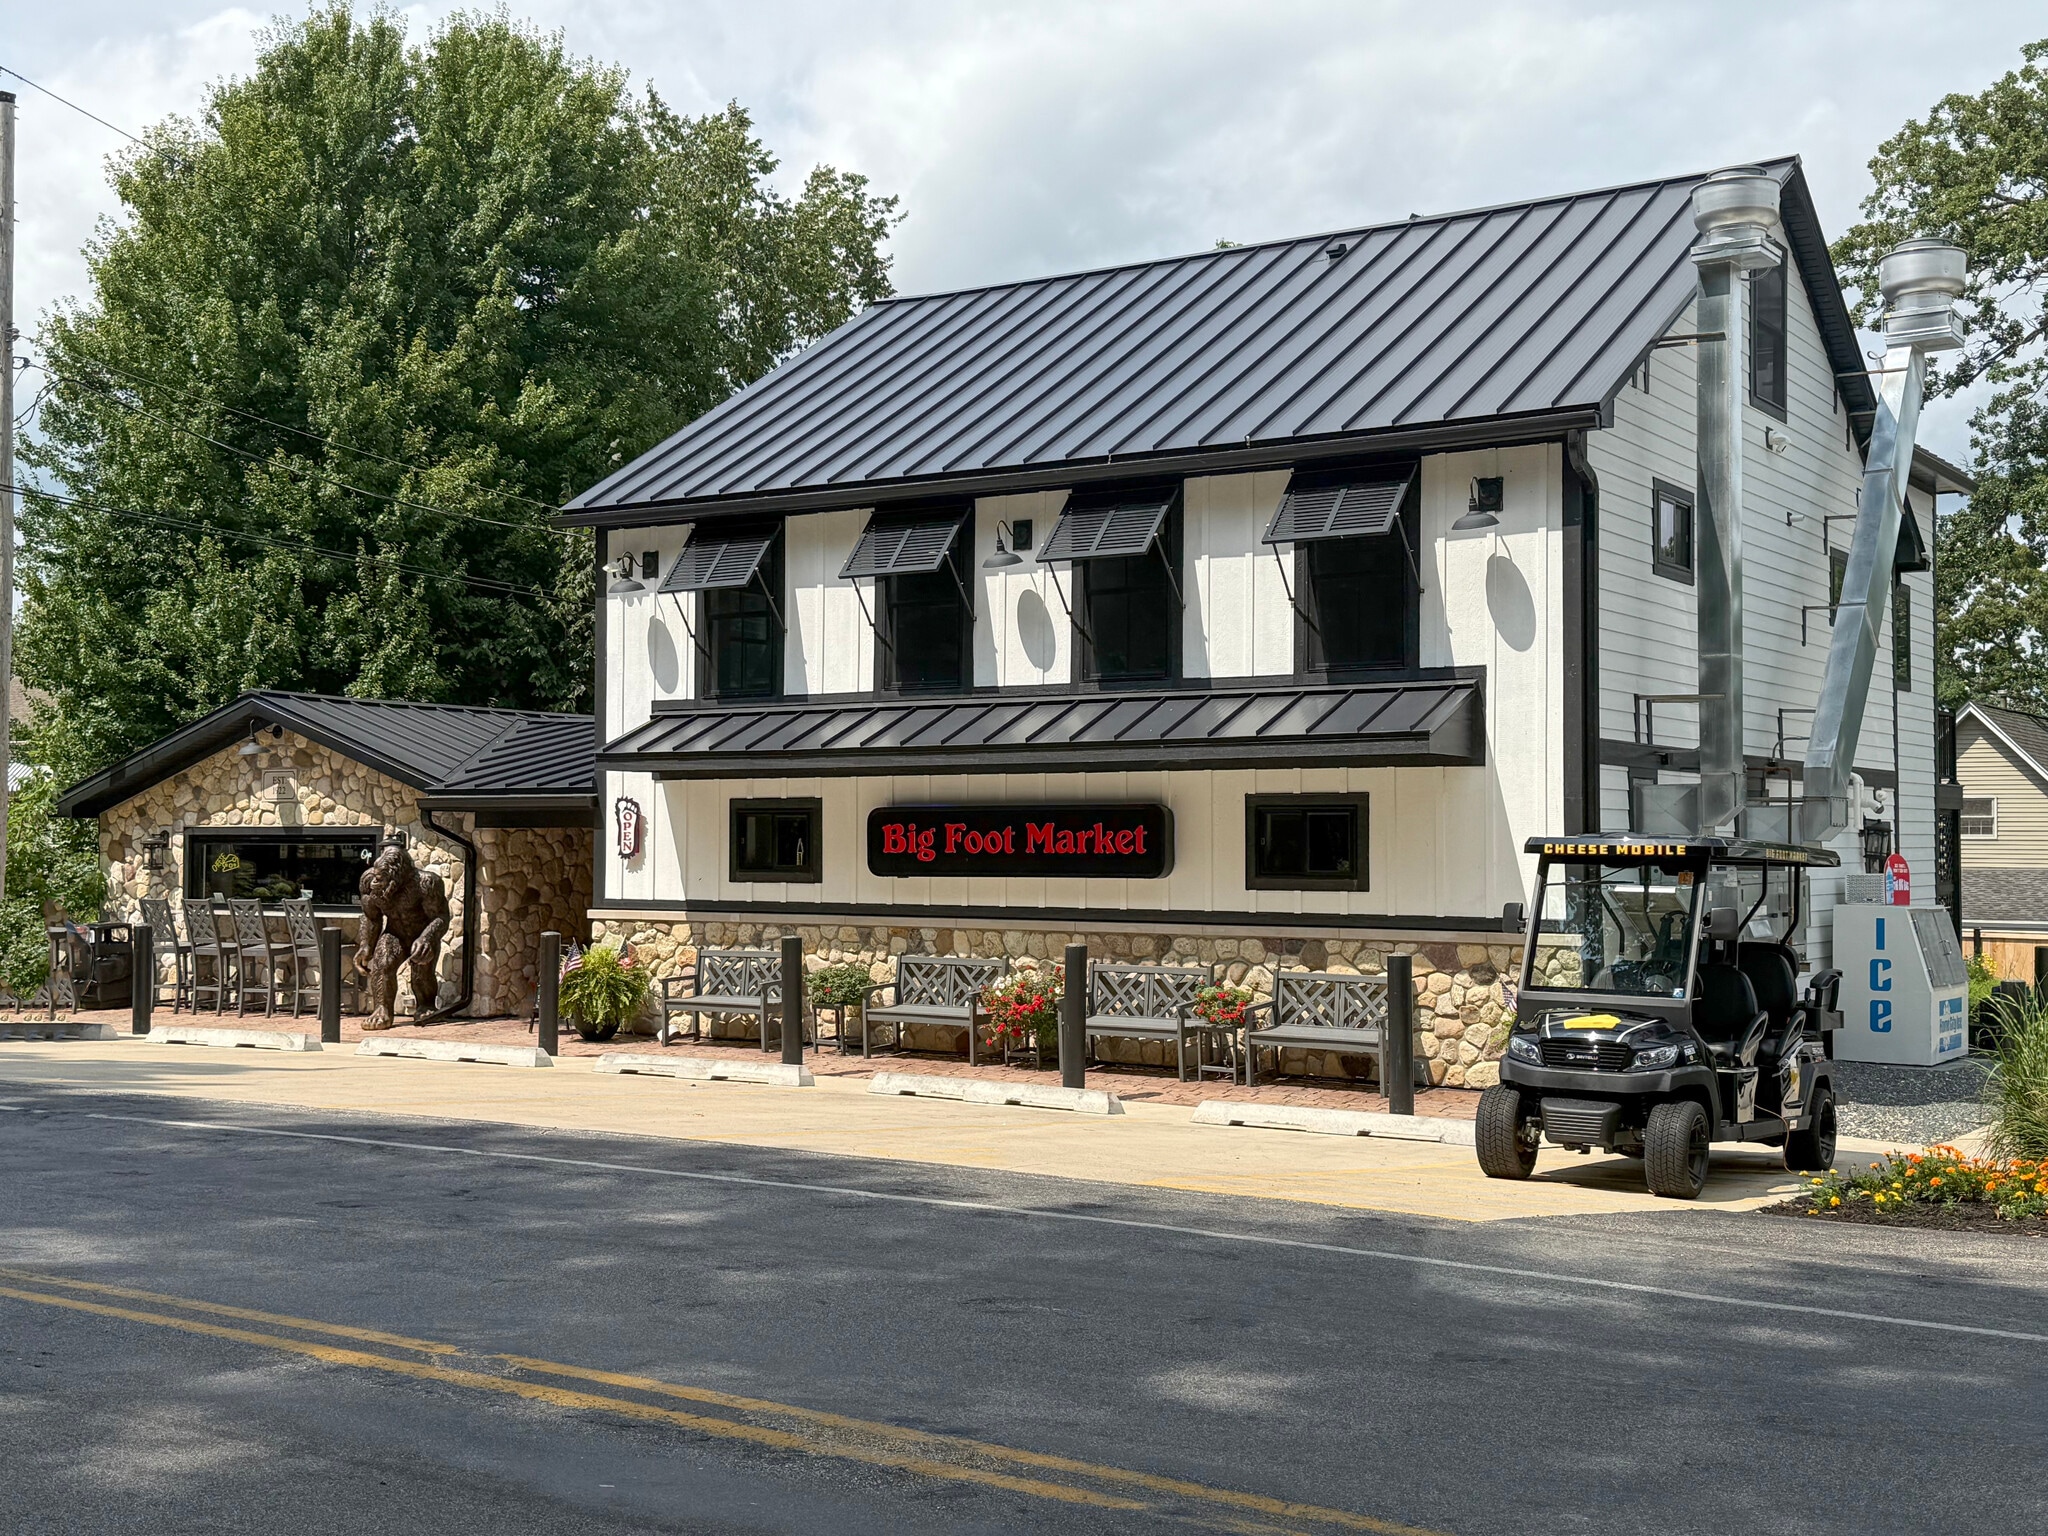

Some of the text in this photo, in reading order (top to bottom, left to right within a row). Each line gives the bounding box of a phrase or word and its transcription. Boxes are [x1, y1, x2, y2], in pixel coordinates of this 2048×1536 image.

[623, 811, 633, 851] OPEN
[881, 822, 1148, 862] Big Foot Market
[1544, 843, 1687, 855] CHEESE MOBILE
